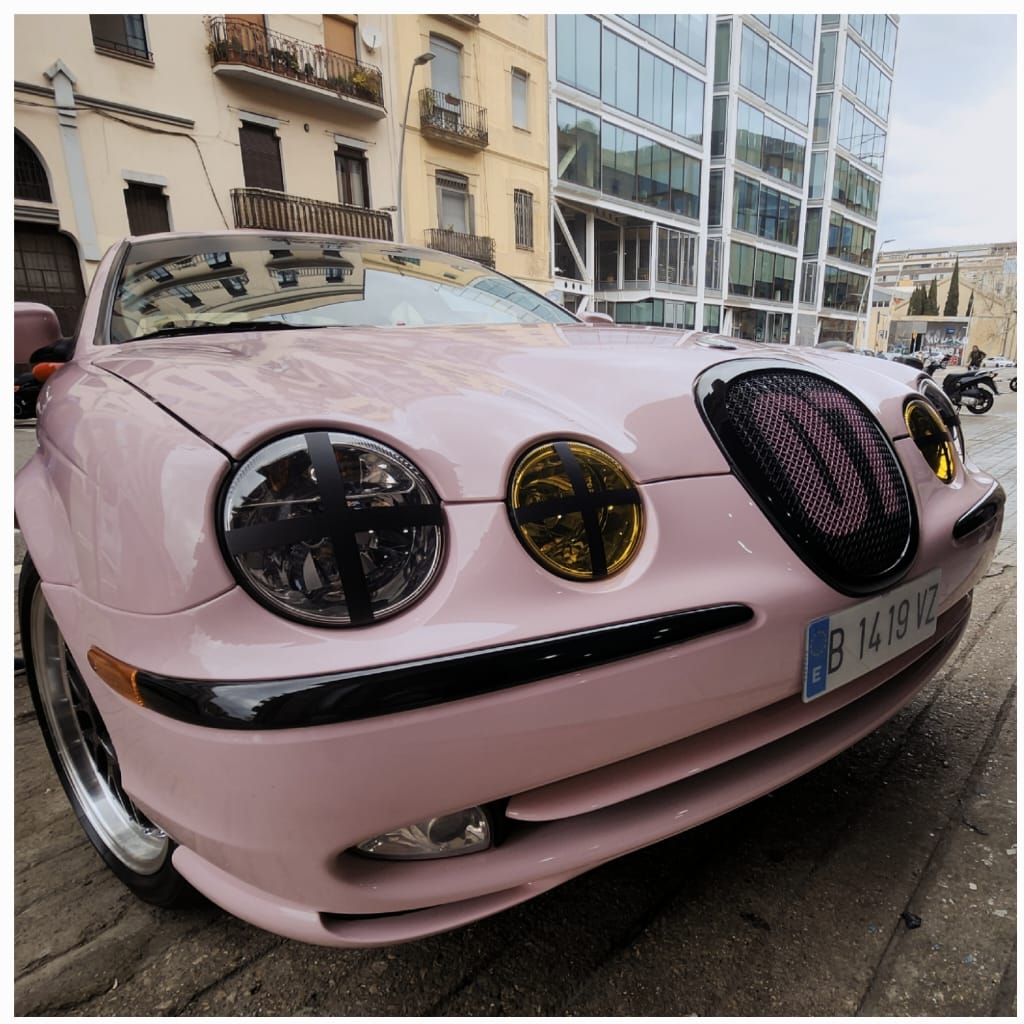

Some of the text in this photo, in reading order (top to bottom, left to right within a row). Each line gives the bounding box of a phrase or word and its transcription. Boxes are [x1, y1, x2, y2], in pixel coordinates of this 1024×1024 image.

[827, 583, 939, 675] B 1419 VZ
[811, 665, 823, 684] E
